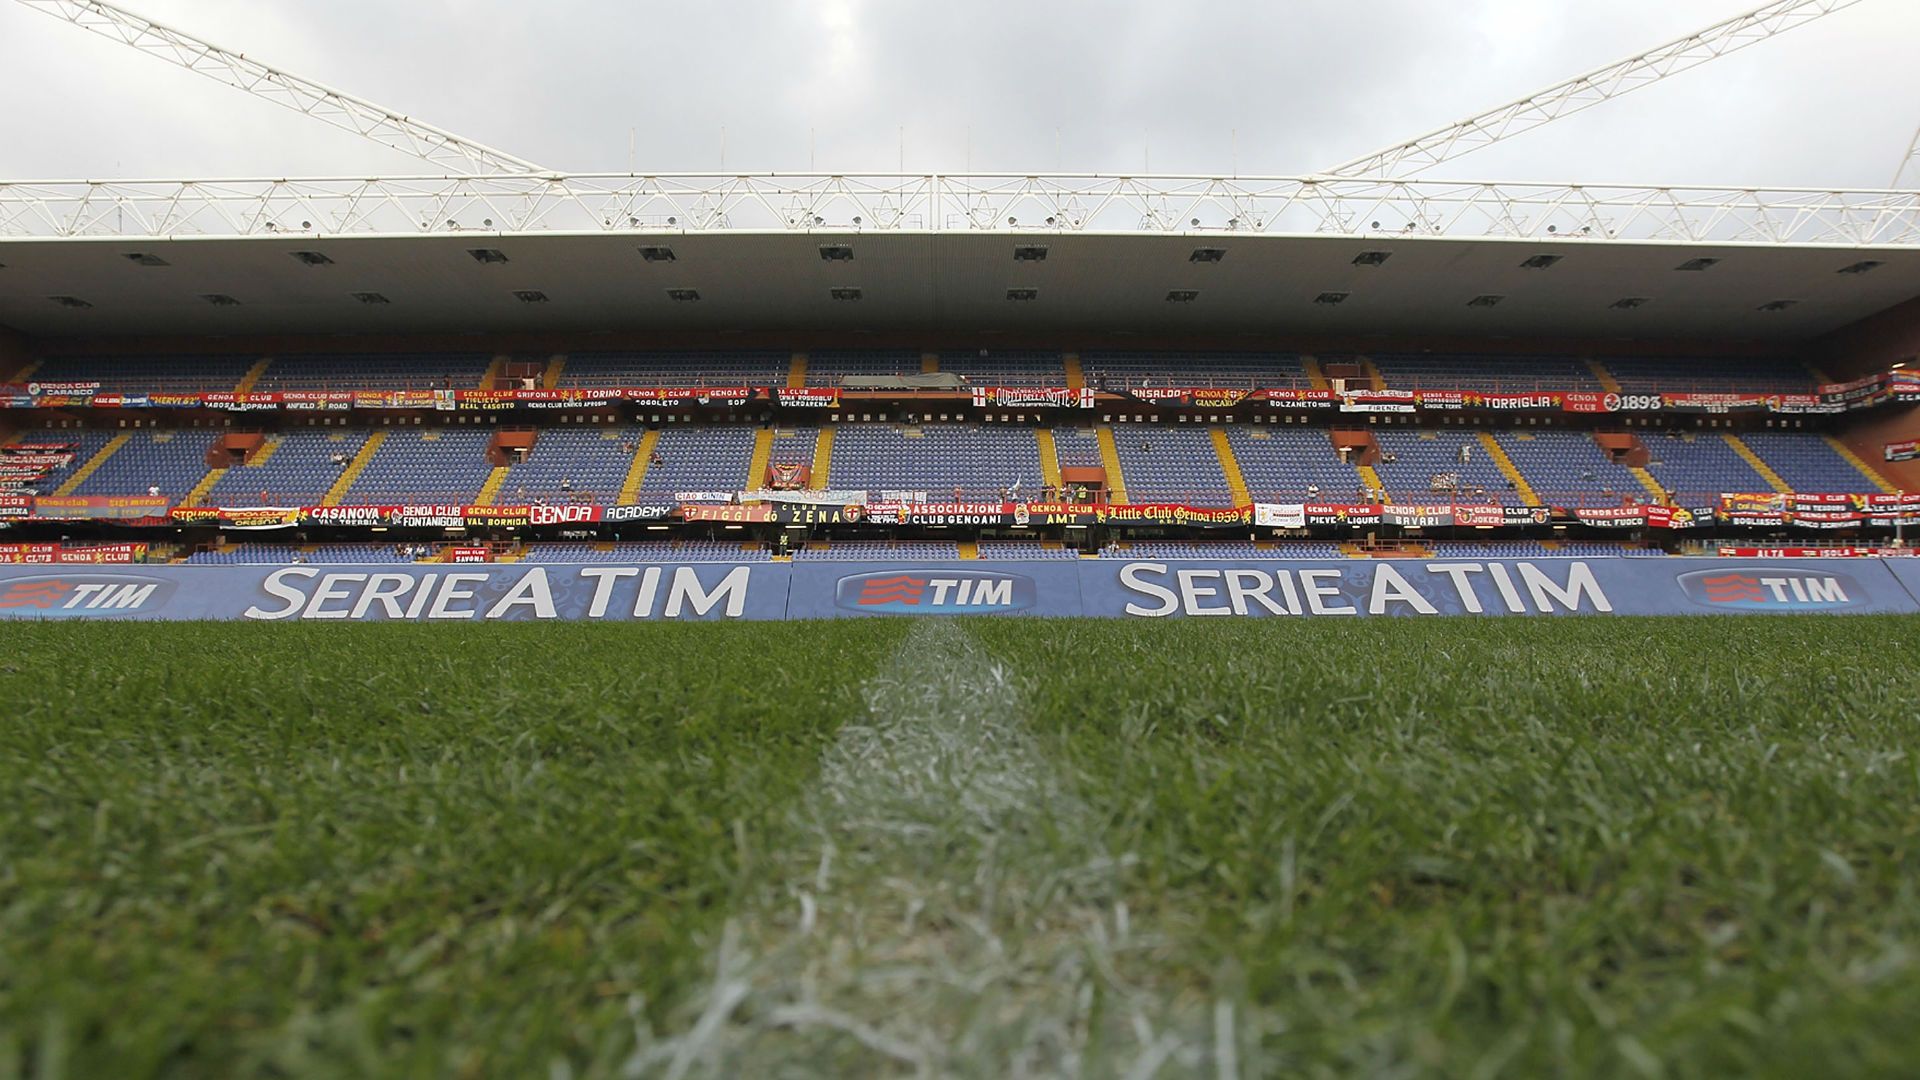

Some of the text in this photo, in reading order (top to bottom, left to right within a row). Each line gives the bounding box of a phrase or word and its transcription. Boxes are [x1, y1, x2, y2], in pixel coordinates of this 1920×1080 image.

[586, 390, 622, 398] TORINO
[1132, 390, 1180, 398] ANSALDO
[1484, 397, 1550, 408] TORRIGLIA
[1622, 396, 1661, 410] 1893
[312, 508, 380, 519] CASANOVA
[403, 506, 460, 516] GENOA CLUB
[530, 506, 670, 524] GENOA ACADEMY
[913, 505, 1002, 514] ASSOCIAZIONE
[1110, 506, 1239, 523] Little Club Genoa 1959
[1384, 506, 1451, 514] GENOA CLUB
[1506, 507, 1529, 515] CLUB
[702, 510, 840, 522] FIGGI ZENA
[912, 515, 1001, 524] CLUB GENOANI
[1046, 514, 1077, 524] AMT
[1396, 517, 1439, 525] BAVARI
[1615, 518, 1643, 526] FUOCO
[244, 566, 750, 619] SERIE A TIM
[928, 579, 1014, 606] TIM
[1120, 562, 1614, 617] SERIE A TIM
[1761, 578, 1850, 603] TIM
[62, 584, 158, 609] TIM
